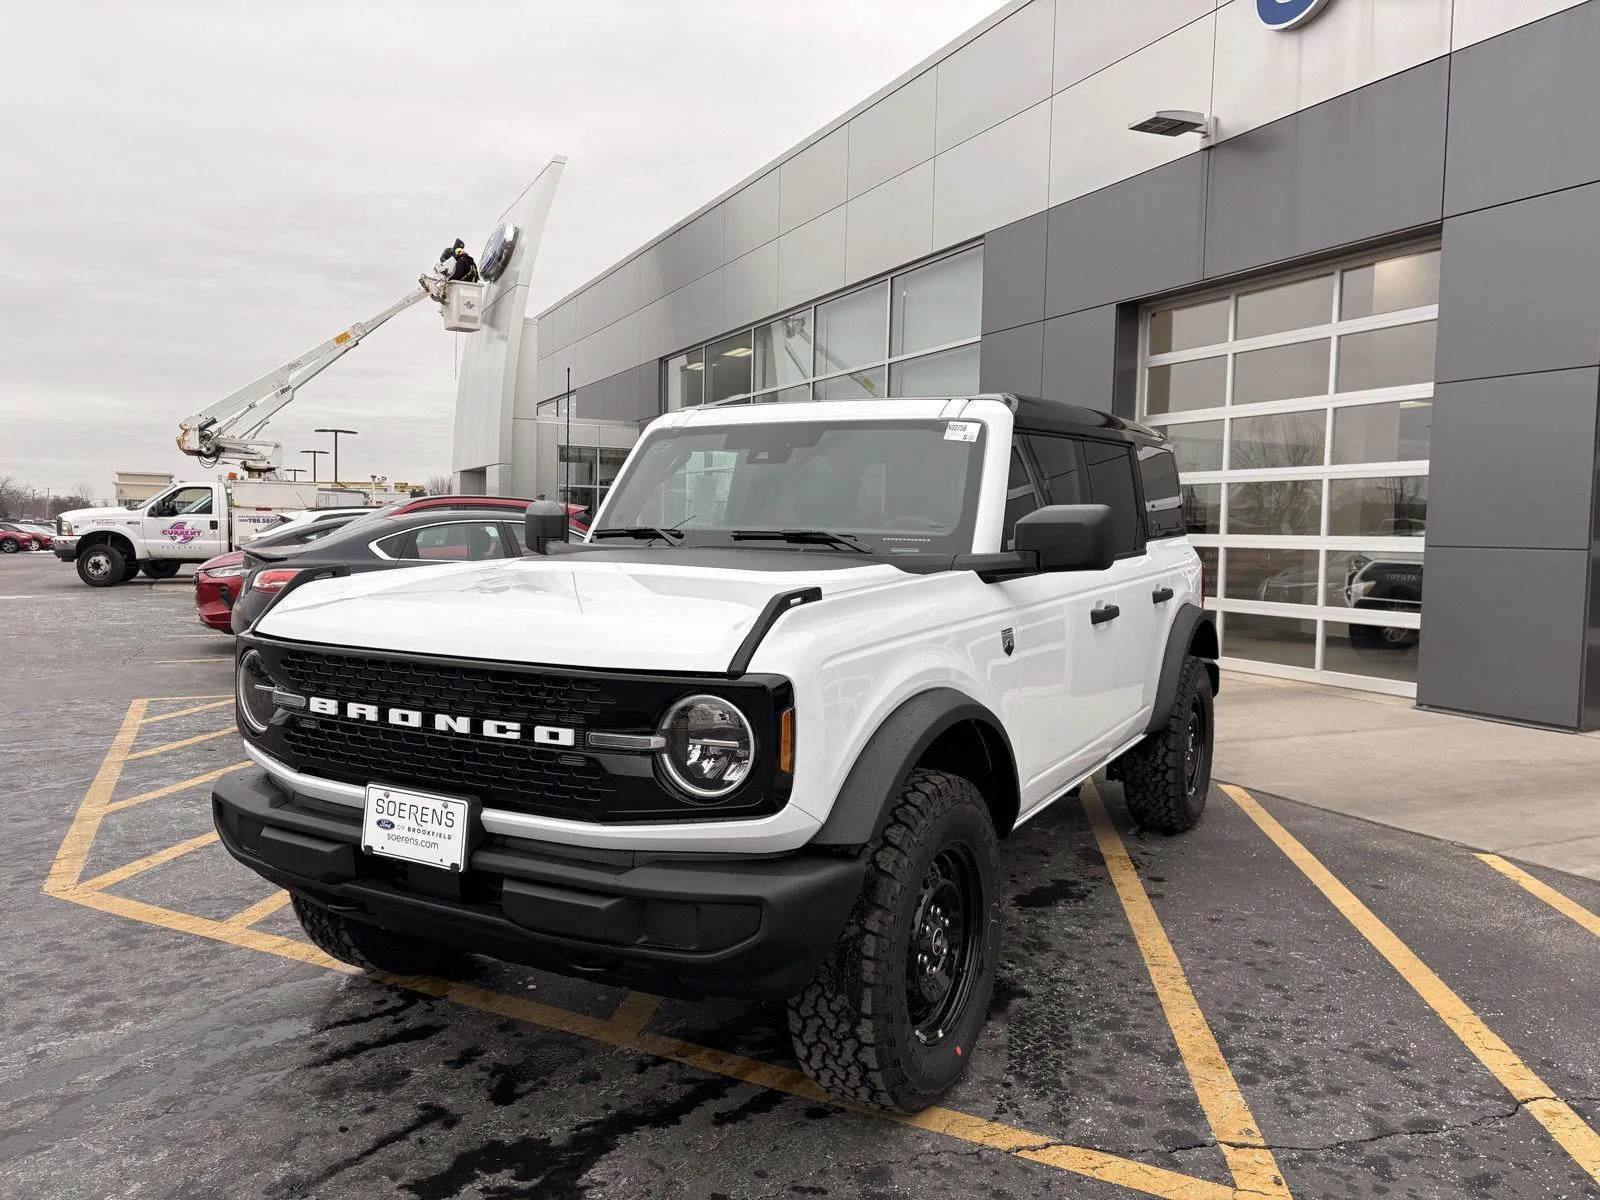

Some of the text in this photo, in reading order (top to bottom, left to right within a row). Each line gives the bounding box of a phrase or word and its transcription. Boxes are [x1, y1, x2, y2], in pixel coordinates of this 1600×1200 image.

[161, 529, 203, 537] CURRENT
[1386, 573, 1417, 581] TOYOTA
[309, 696, 575, 747] BRONCO
[375, 798, 455, 828] SOERENS
[378, 819, 394, 829] Ford
[407, 826, 452, 840] BROOKFIELD
[386, 833, 439, 850] soerens.com
